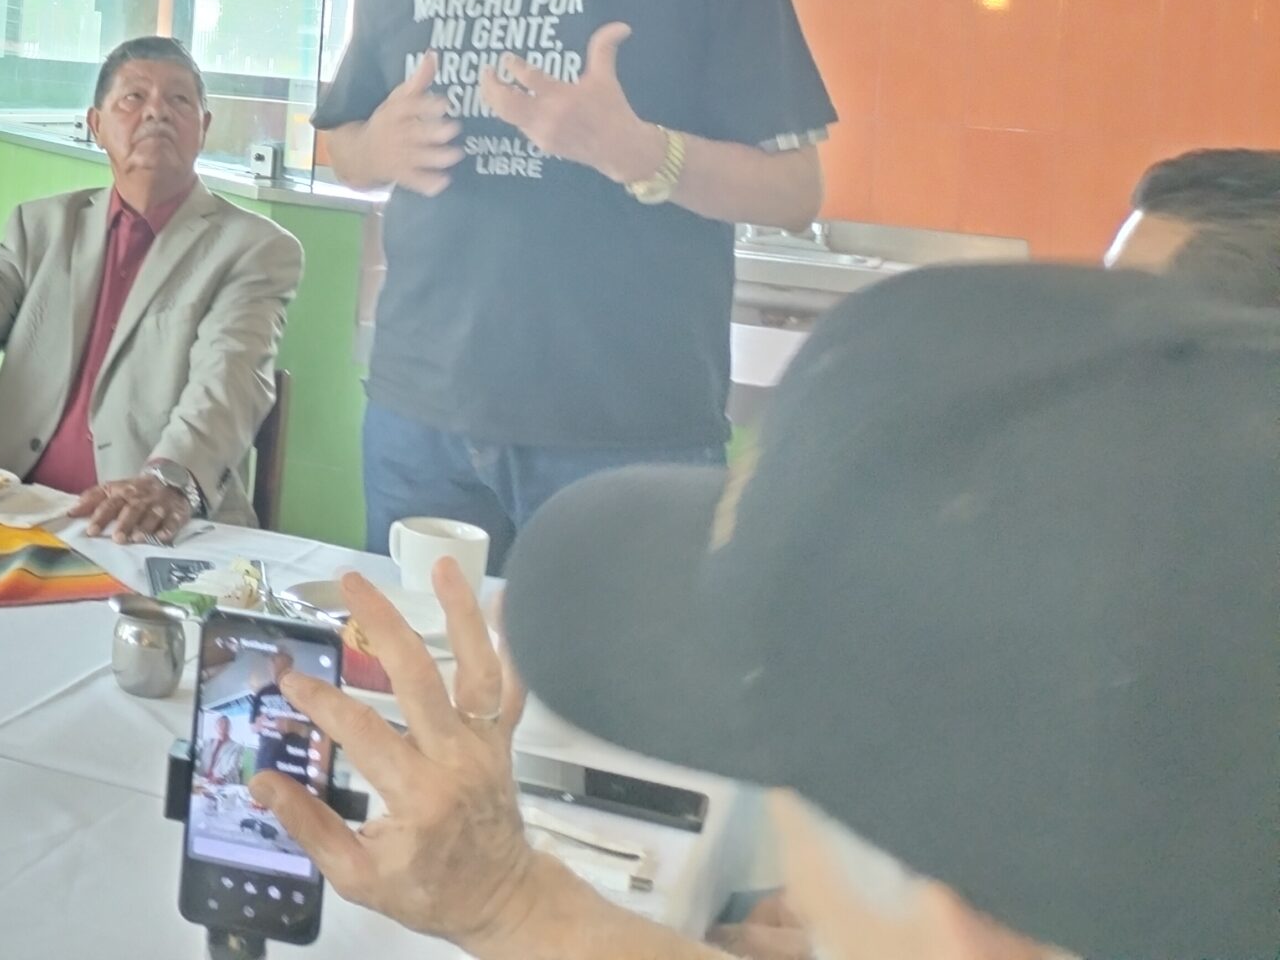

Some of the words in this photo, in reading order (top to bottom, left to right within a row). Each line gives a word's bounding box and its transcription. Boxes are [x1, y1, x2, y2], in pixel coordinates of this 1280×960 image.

[430, 17, 466, 50] MI
[471, 15, 563, 53] GENTE,
[476, 155, 544, 179] LIBRE
